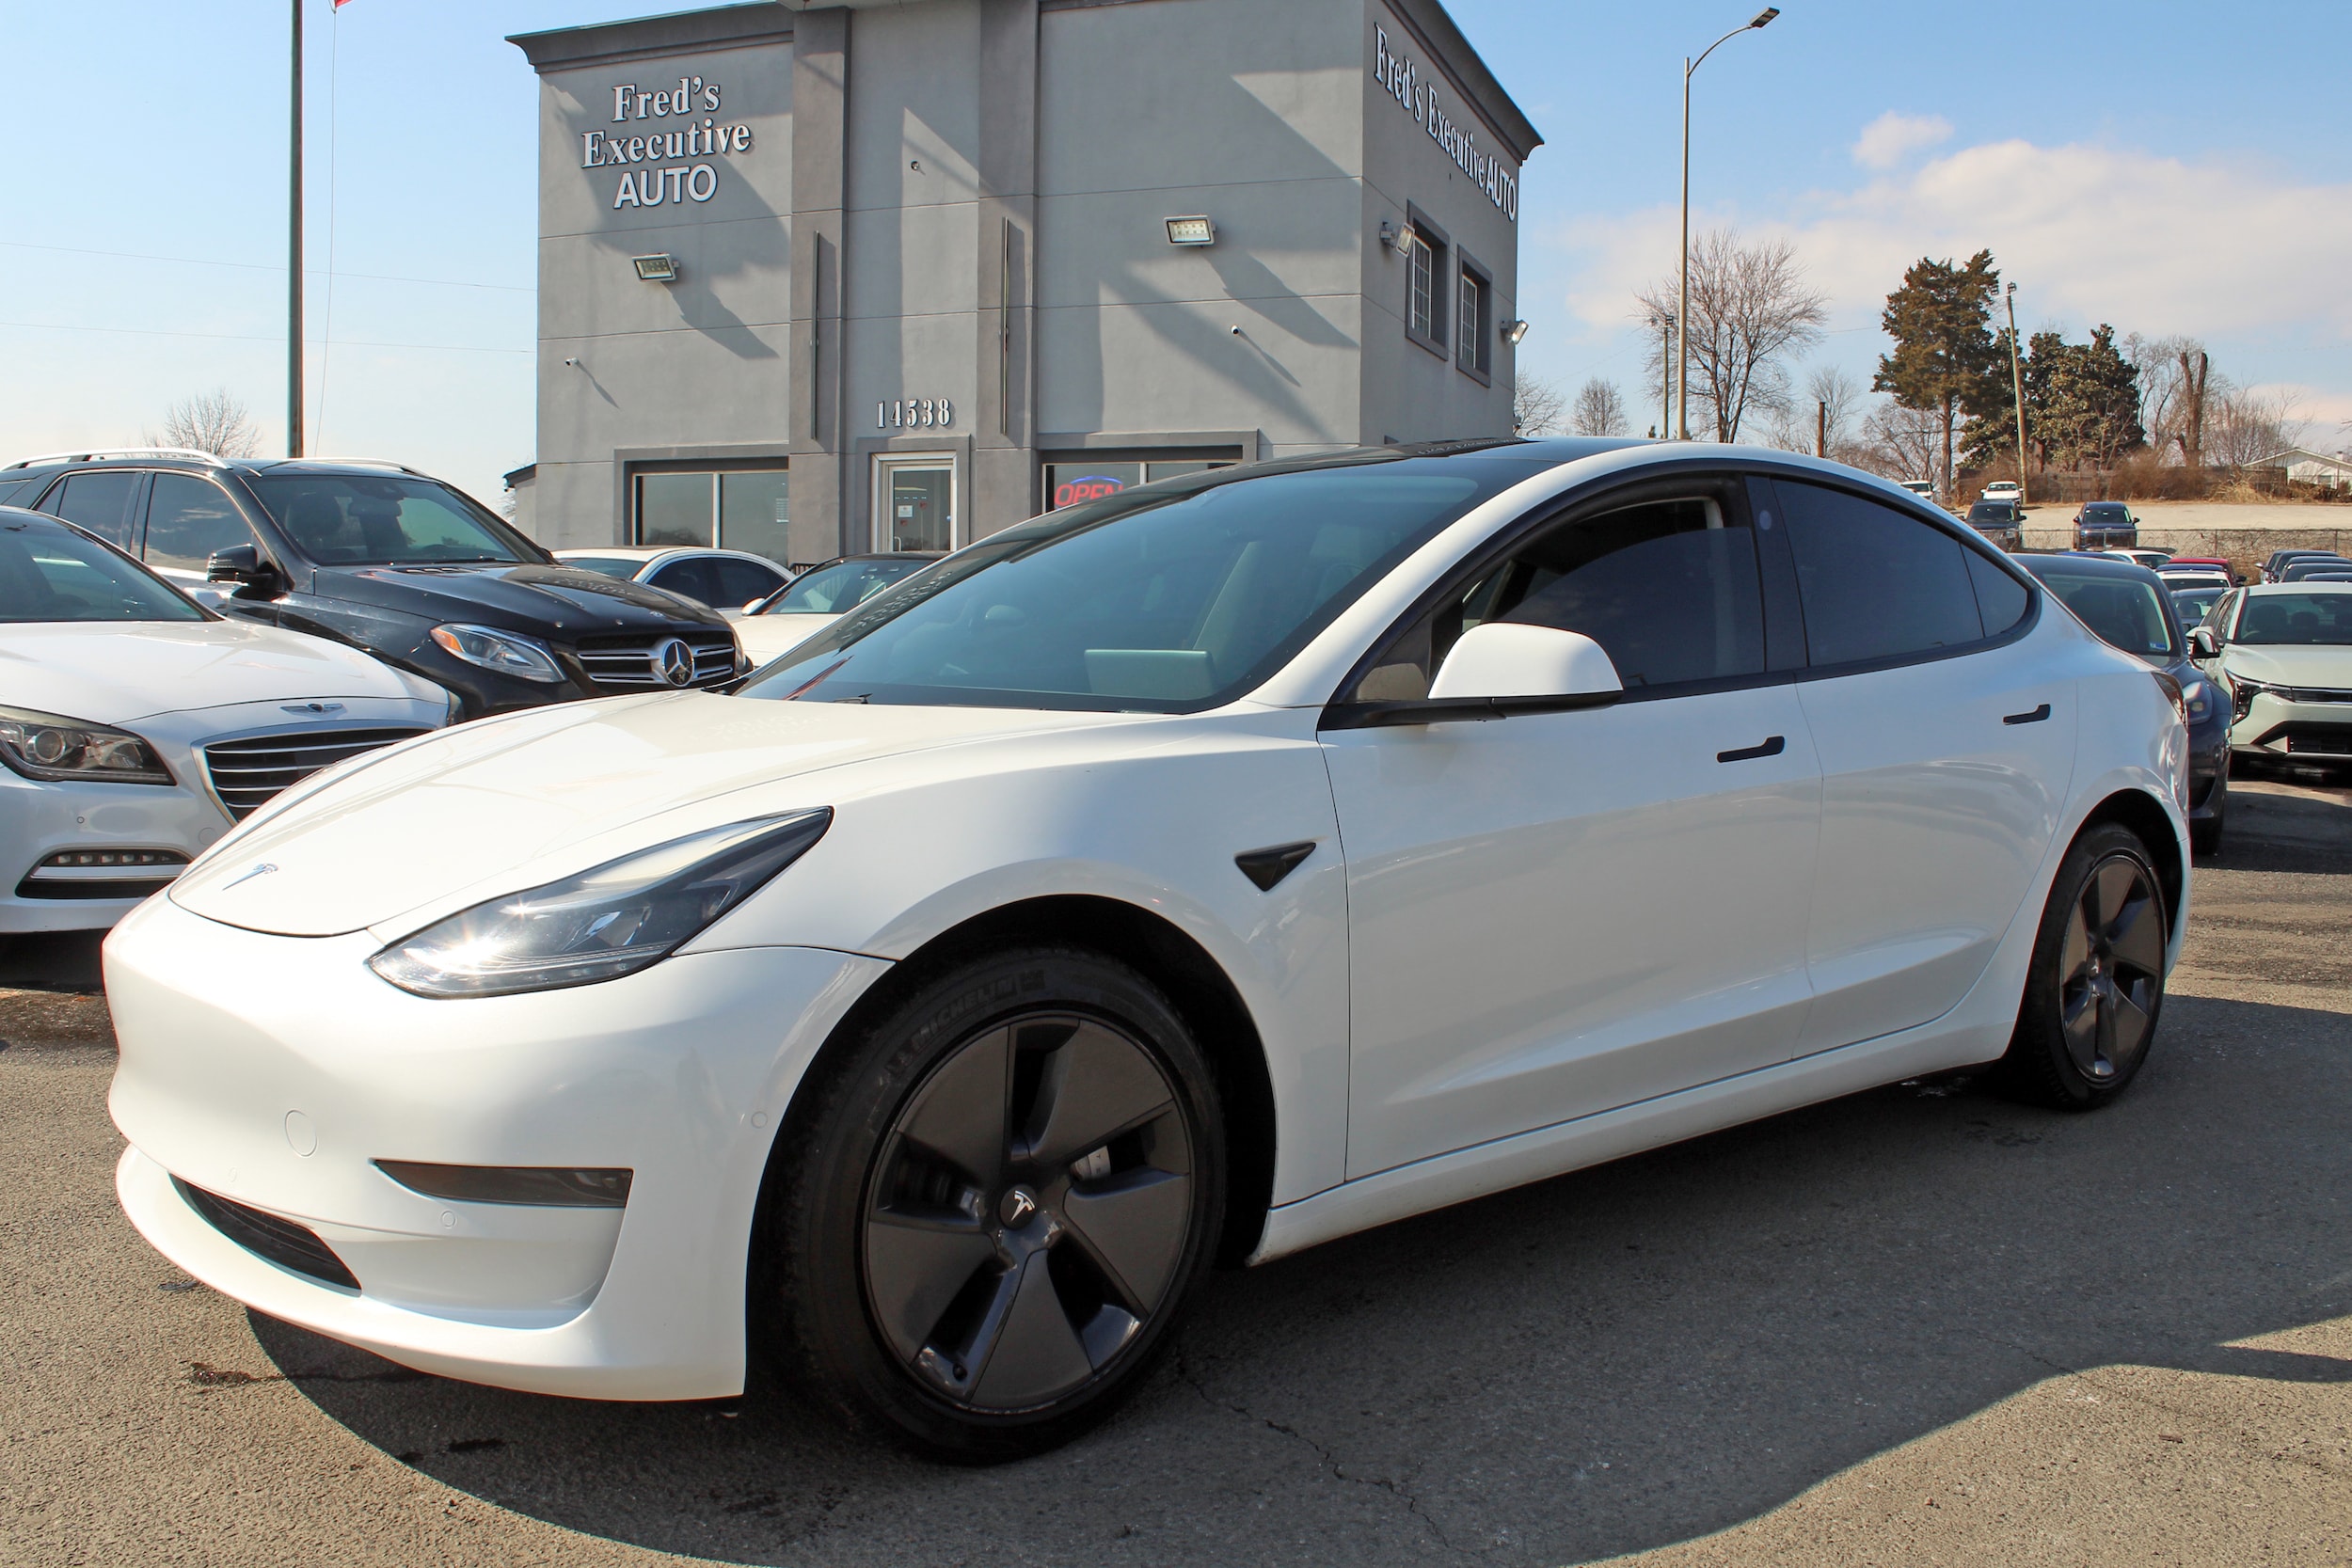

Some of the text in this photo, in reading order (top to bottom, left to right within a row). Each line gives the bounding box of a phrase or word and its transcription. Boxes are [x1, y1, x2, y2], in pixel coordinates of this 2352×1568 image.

[612, 75, 721, 122] Fred's
[1375, 22, 1517, 222] Fred's Executive AUTO
[580, 118, 752, 168] Executive
[613, 164, 719, 209] AUTO
[877, 398, 950, 428] 14538
[911, 979, 1017, 1049] MICHELIN
